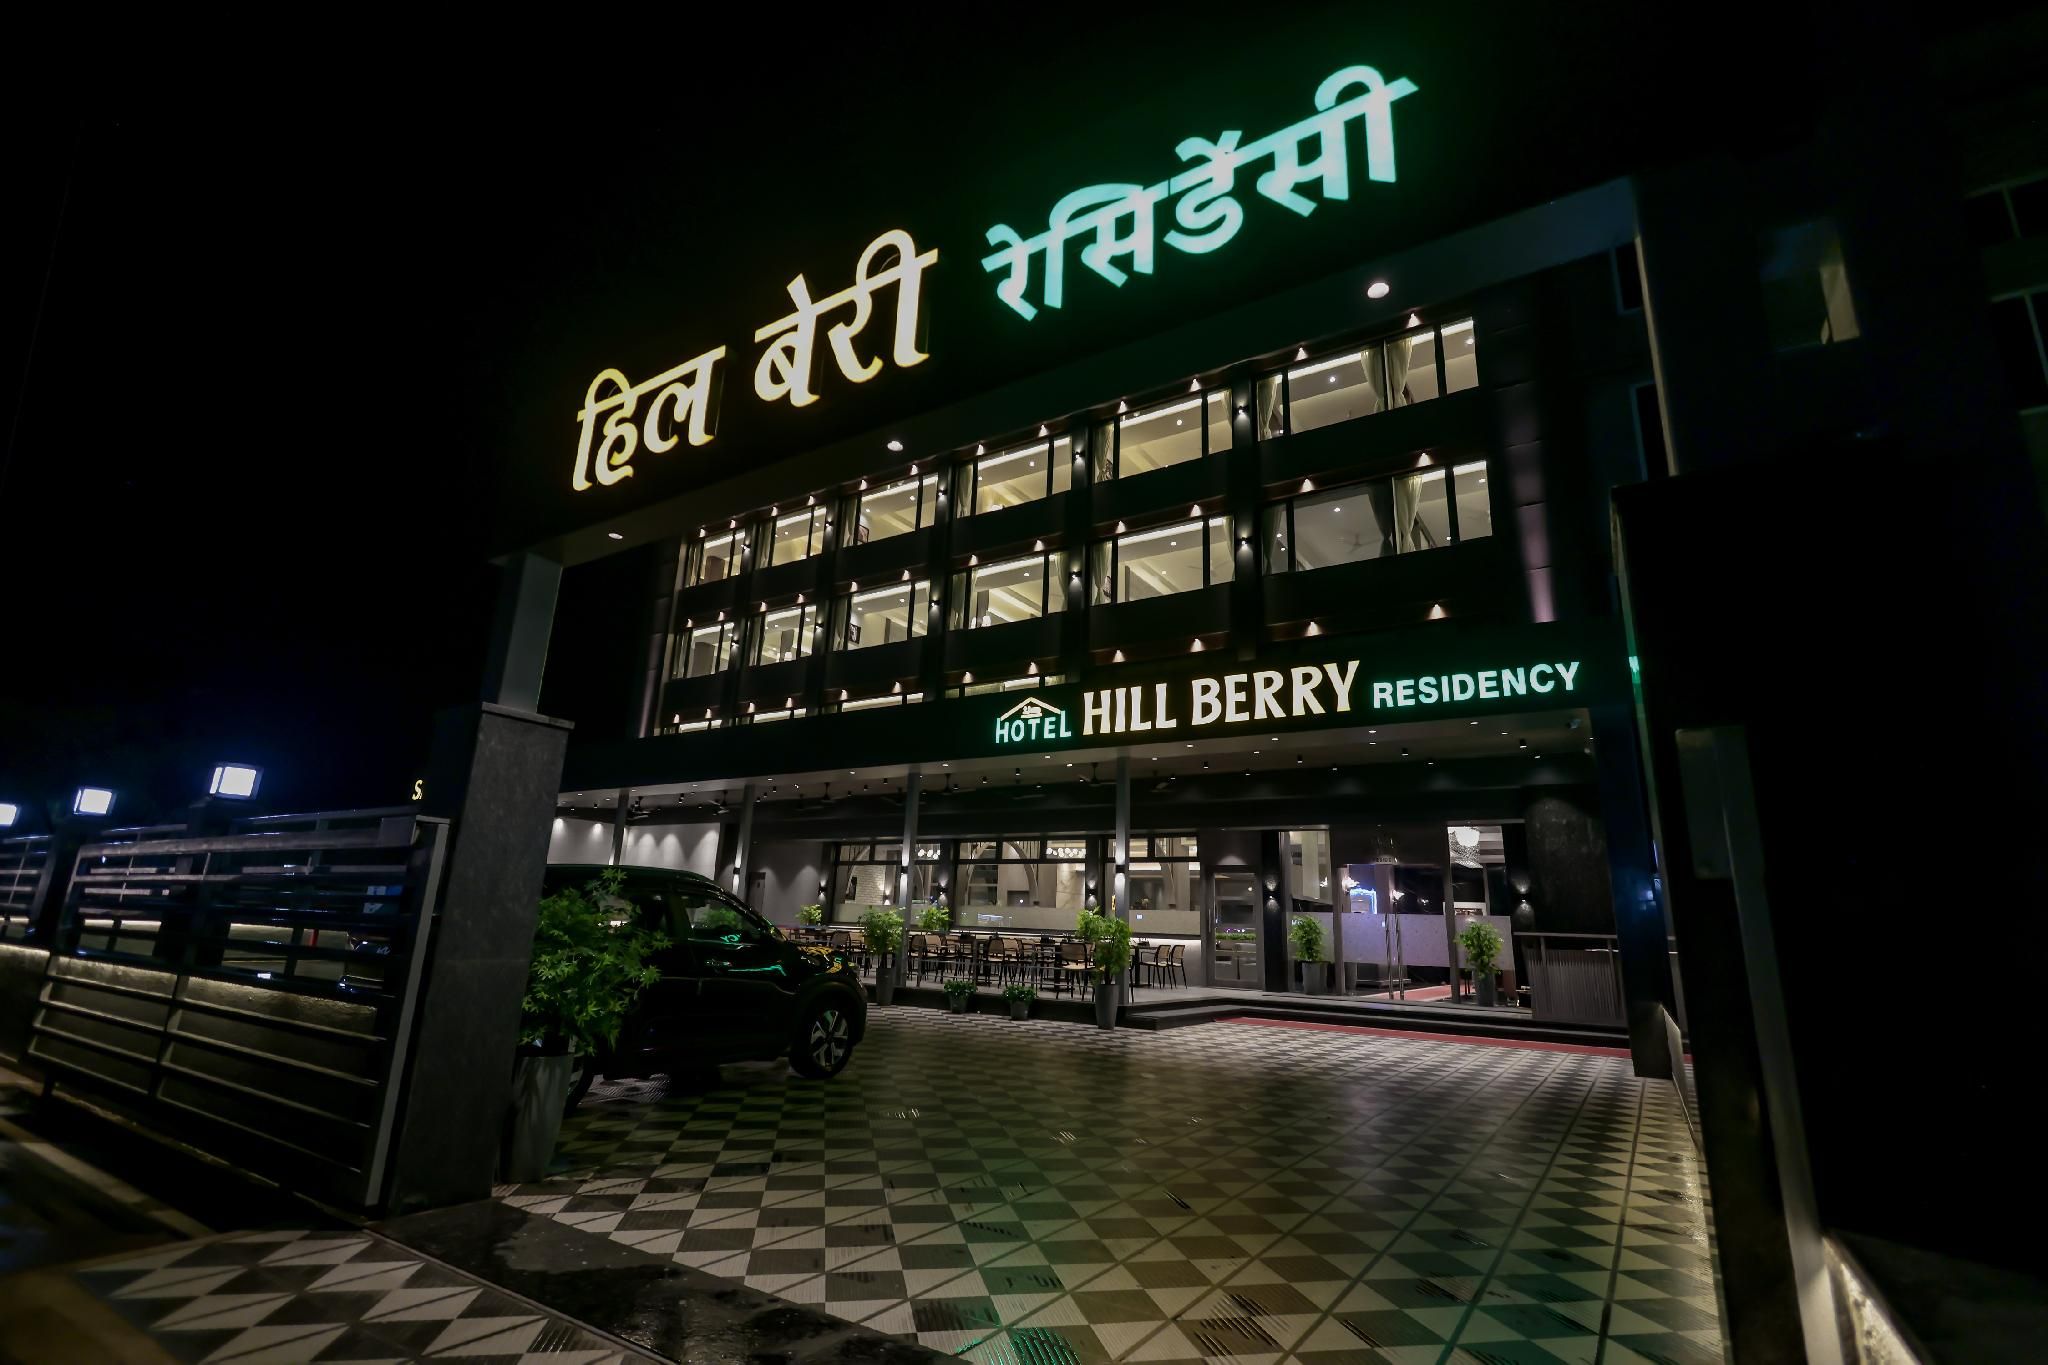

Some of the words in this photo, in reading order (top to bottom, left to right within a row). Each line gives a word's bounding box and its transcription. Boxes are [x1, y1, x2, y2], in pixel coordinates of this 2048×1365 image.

[573, 368, 726, 491] हिल
[754, 229, 938, 408] बेरी
[995, 710, 1072, 744] HOTEL
[1083, 683, 1177, 735] HILL
[1191, 660, 1360, 726] BERRY
[1373, 661, 1580, 709] RESIDENCY
